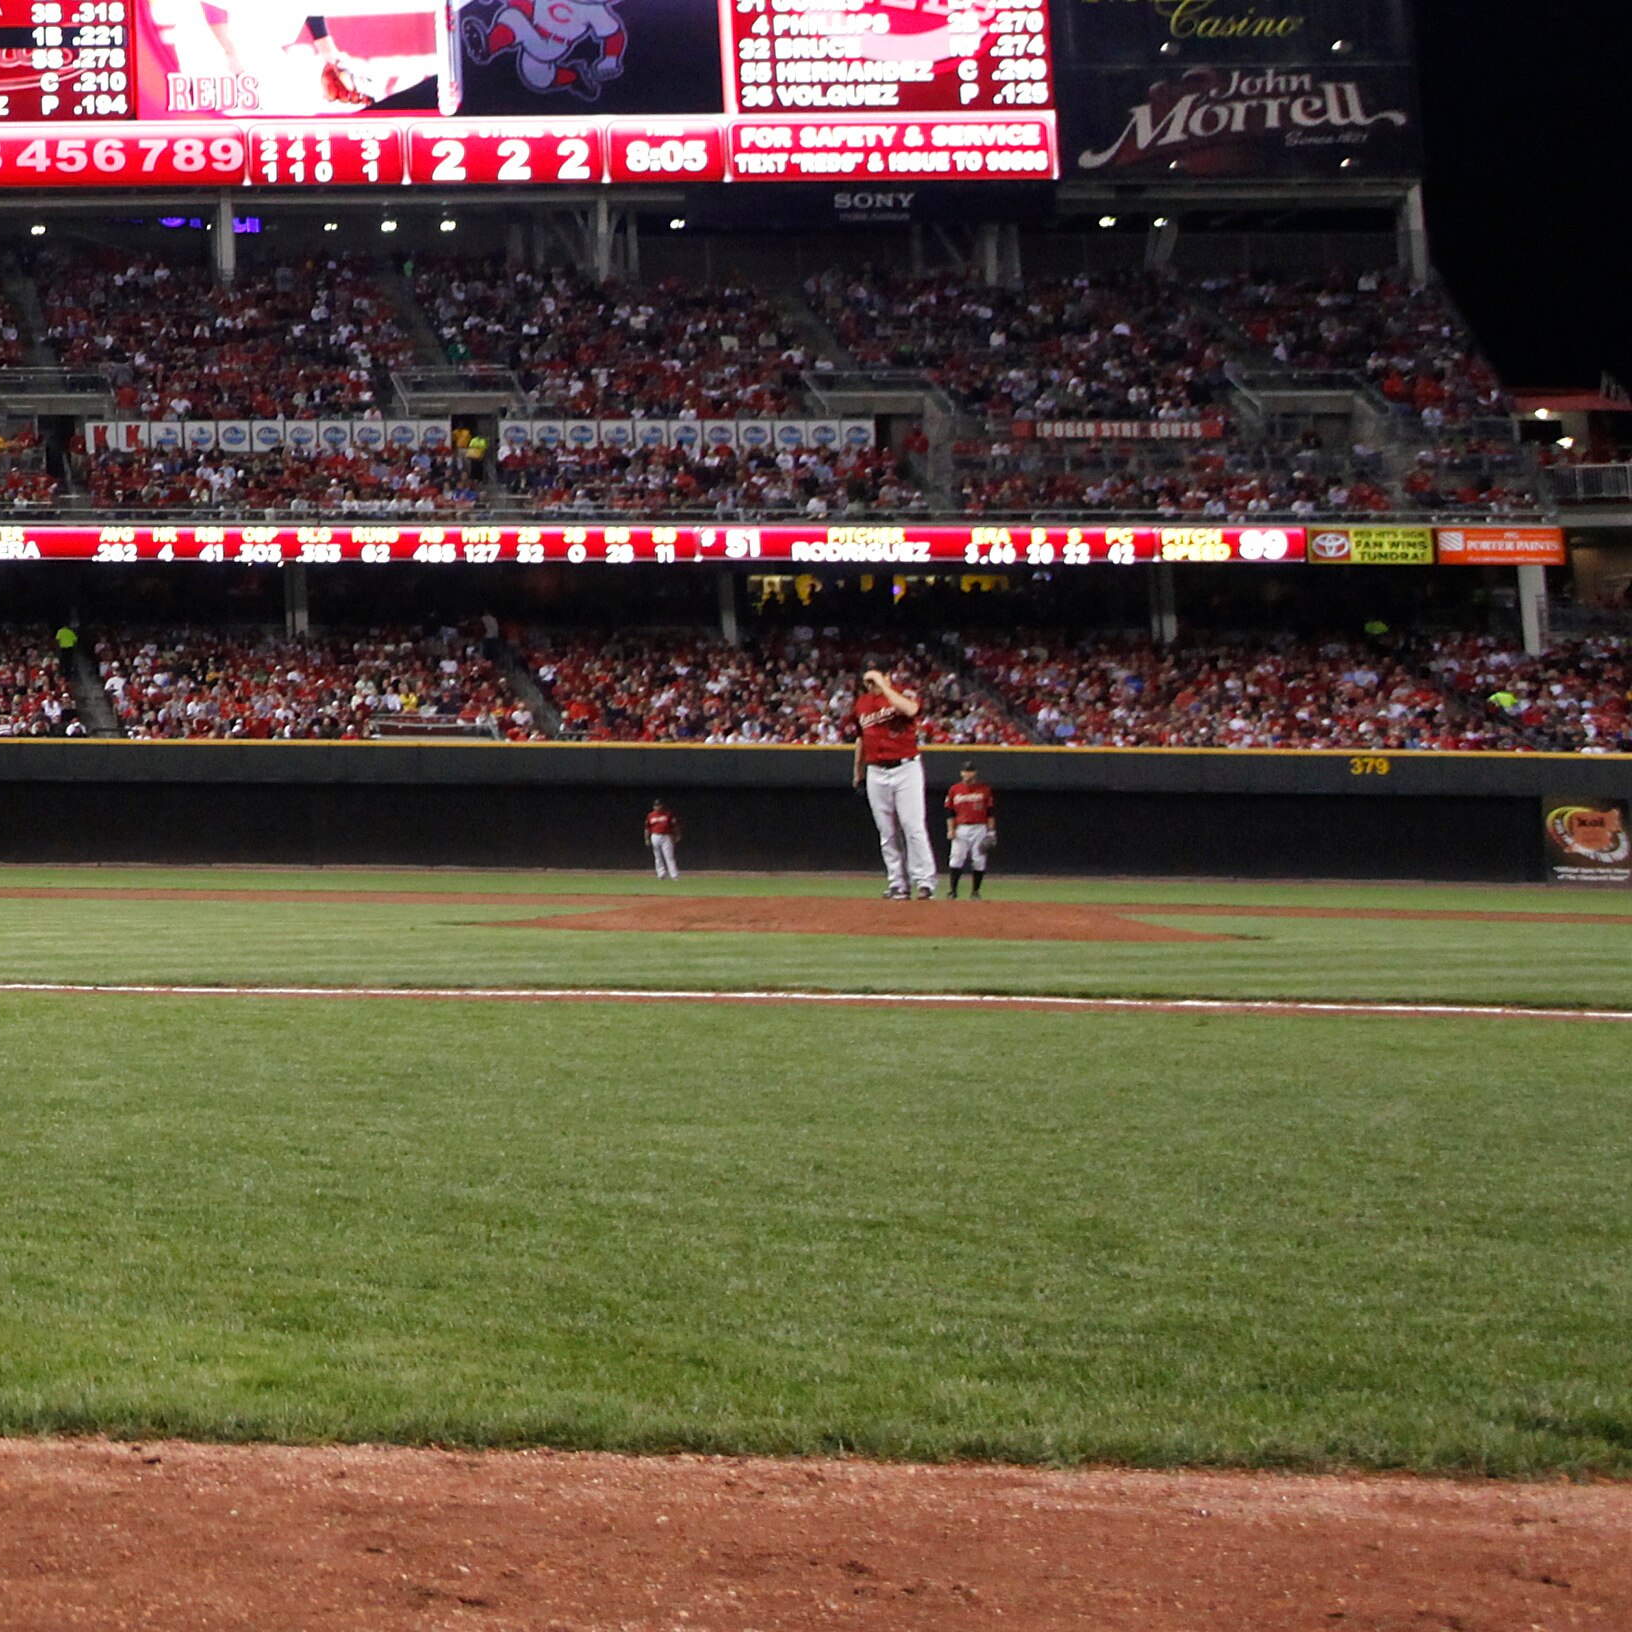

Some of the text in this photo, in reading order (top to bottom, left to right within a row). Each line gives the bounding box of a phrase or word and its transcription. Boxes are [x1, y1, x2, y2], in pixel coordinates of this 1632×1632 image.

[773, 13, 890, 35] PHILLIPS
[1169, 0, 1305, 40] Casino
[775, 37, 862, 59] BRUCE
[775, 60, 934, 82] HERNANDEZ
[167, 72, 261, 112] REDS
[1209, 68, 1313, 99] John
[776, 84, 899, 106] VOLQUEZ
[1077, 80, 1408, 168] Morrell
[740, 125, 1041, 148] FOR SAFETY & SERVICE
[431, 138, 591, 181] 2 2 2
[625, 139, 708, 172] 8:05
[833, 192, 916, 208] SONY
[725, 528, 761, 557] 51
[1161, 527, 1223, 544] PITCH
[1354, 540, 1428, 550] FAN WINS
[1466, 540, 1514, 551] PORTER
[156, 544, 175, 563] 4
[199, 544, 224, 562] 41
[463, 544, 500, 563] 127
[792, 542, 931, 562] RODRIGUEZ
[1062, 543, 1091, 564] 22
[1106, 543, 1136, 564] 42
[1160, 543, 1231, 561] SPEED
[1349, 756, 1391, 775] 379
